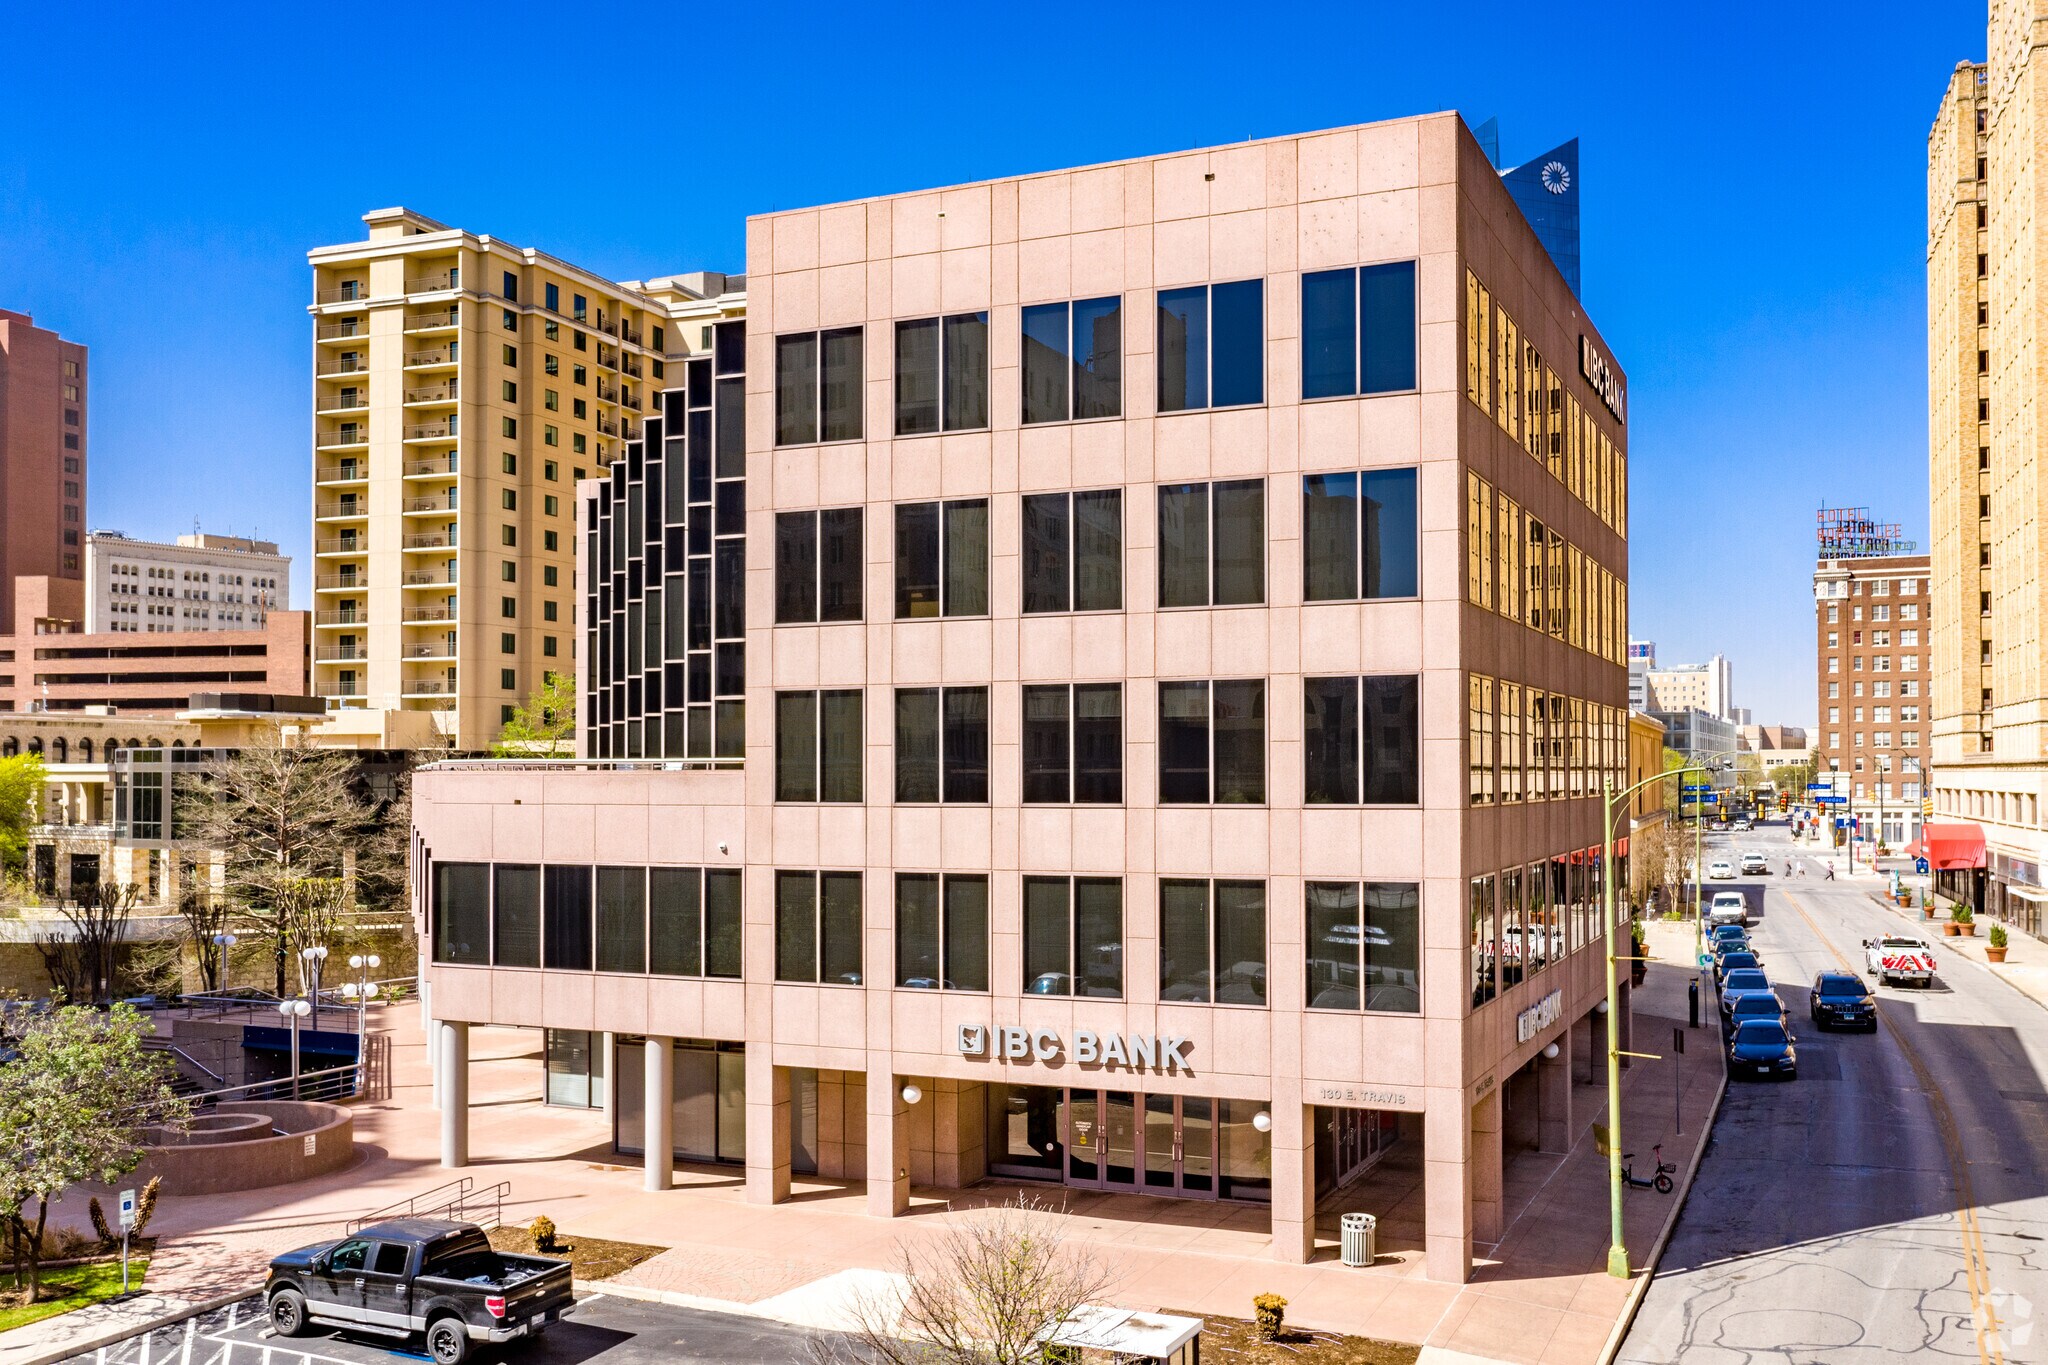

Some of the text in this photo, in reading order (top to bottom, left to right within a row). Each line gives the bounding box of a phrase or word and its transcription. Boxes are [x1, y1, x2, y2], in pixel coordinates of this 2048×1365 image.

[1590, 344, 1625, 425] IBC BANK
[1817, 508, 1865, 523] HOTEL
[1876, 524, 1902, 538] LEE
[993, 1024, 1190, 1069] IBC BANK
[1320, 1089, 1406, 1104] 130 E. TRAVIS
